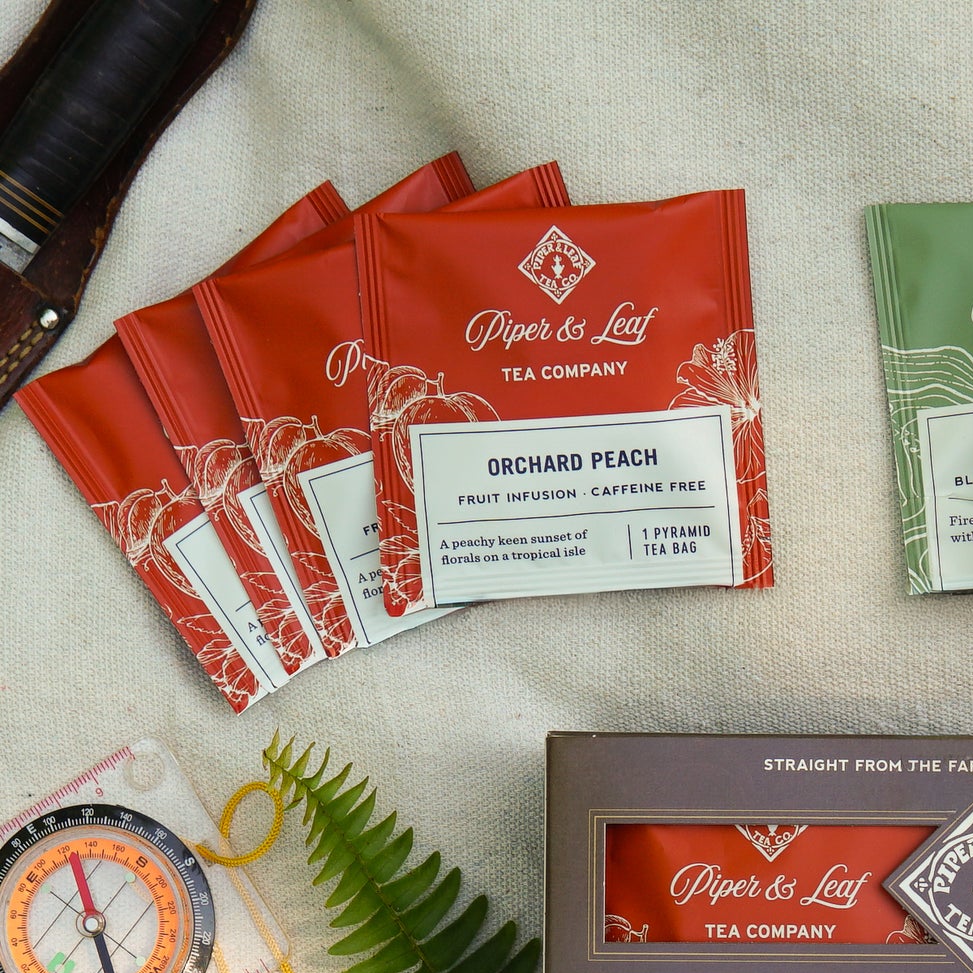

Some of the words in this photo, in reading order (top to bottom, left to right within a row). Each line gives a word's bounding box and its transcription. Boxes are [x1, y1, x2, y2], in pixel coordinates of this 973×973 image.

[465, 309, 552, 351] Piper
[557, 316, 585, 342] &
[591, 302, 659, 346] Leaf
[502, 366, 537, 382] TEA
[541, 361, 627, 380] COMPANY
[488, 453, 583, 476] ORCHARD
[592, 449, 658, 470] PEACH
[458, 493, 500, 505] FRUIT
[507, 488, 576, 503] INFUSION
[591, 483, 664, 496] CAFFEINE
[670, 481, 705, 492] FREE
[440, 540, 450, 549] A
[453, 537, 495, 551] peachy
[499, 534, 528, 547] keen
[531, 532, 570, 544] sunset
[574, 529, 588, 541] of
[642, 528, 648, 540] 1
[654, 525, 711, 540] PYRAMID
[441, 551, 481, 565] florals
[484, 552, 499, 562] on
[502, 552, 509, 561] a
[512, 548, 560, 563] tropical
[563, 546, 586, 558] isle
[644, 544, 668, 556] TEA
[673, 541, 696, 554] BAG
[764, 759, 848, 771] STRAIGHT
[855, 759, 902, 771] FROM
[908, 760, 941, 771] THE
[81, 808, 94, 816] 120
[120, 812, 132, 822] 140
[185, 857, 195, 867] S
[670, 863, 762, 905] Piper
[765, 874, 796, 900] &
[800, 864, 872, 909] Leaf
